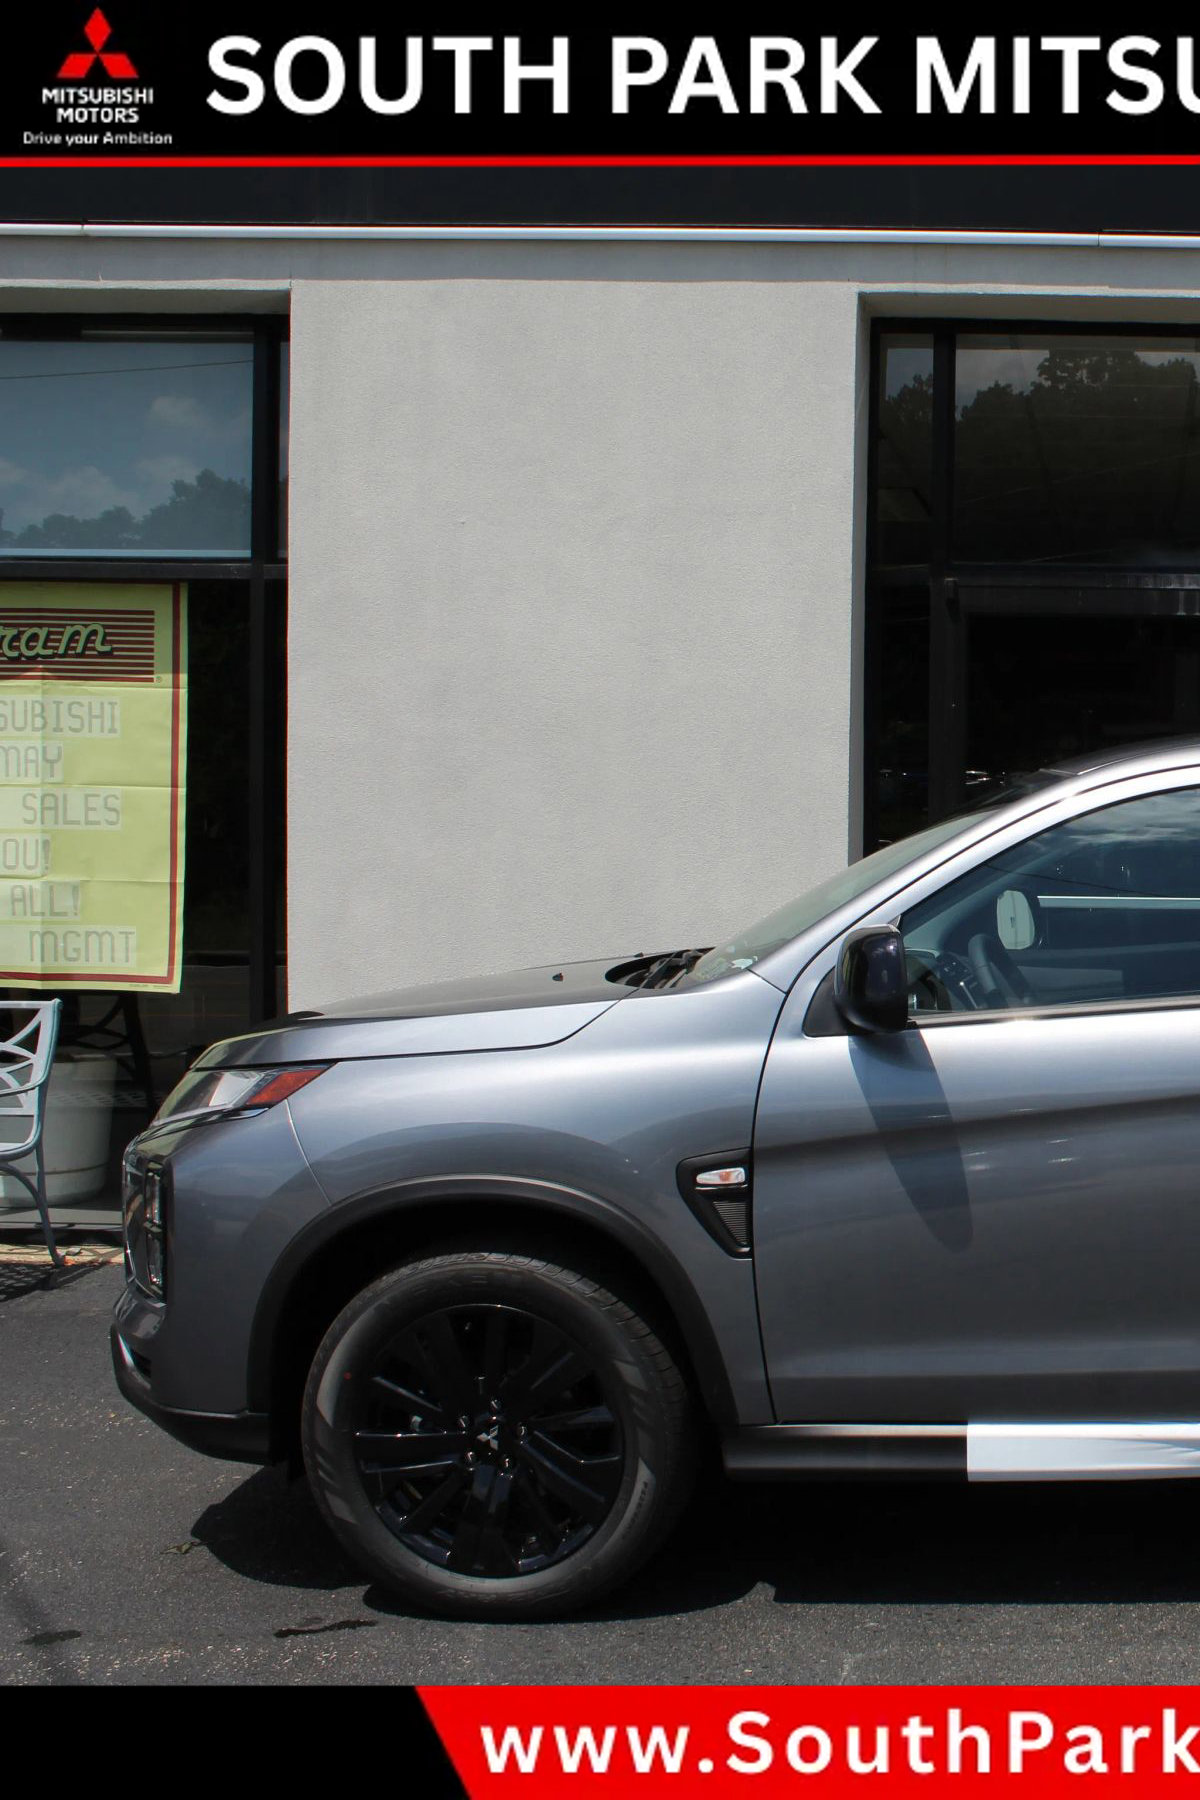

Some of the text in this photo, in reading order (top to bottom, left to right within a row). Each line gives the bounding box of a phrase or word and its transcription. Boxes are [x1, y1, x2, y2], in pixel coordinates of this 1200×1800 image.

[22, 792, 121, 827] SALES
[10, 884, 80, 918] ALL!
[29, 930, 136, 964] MGMT
